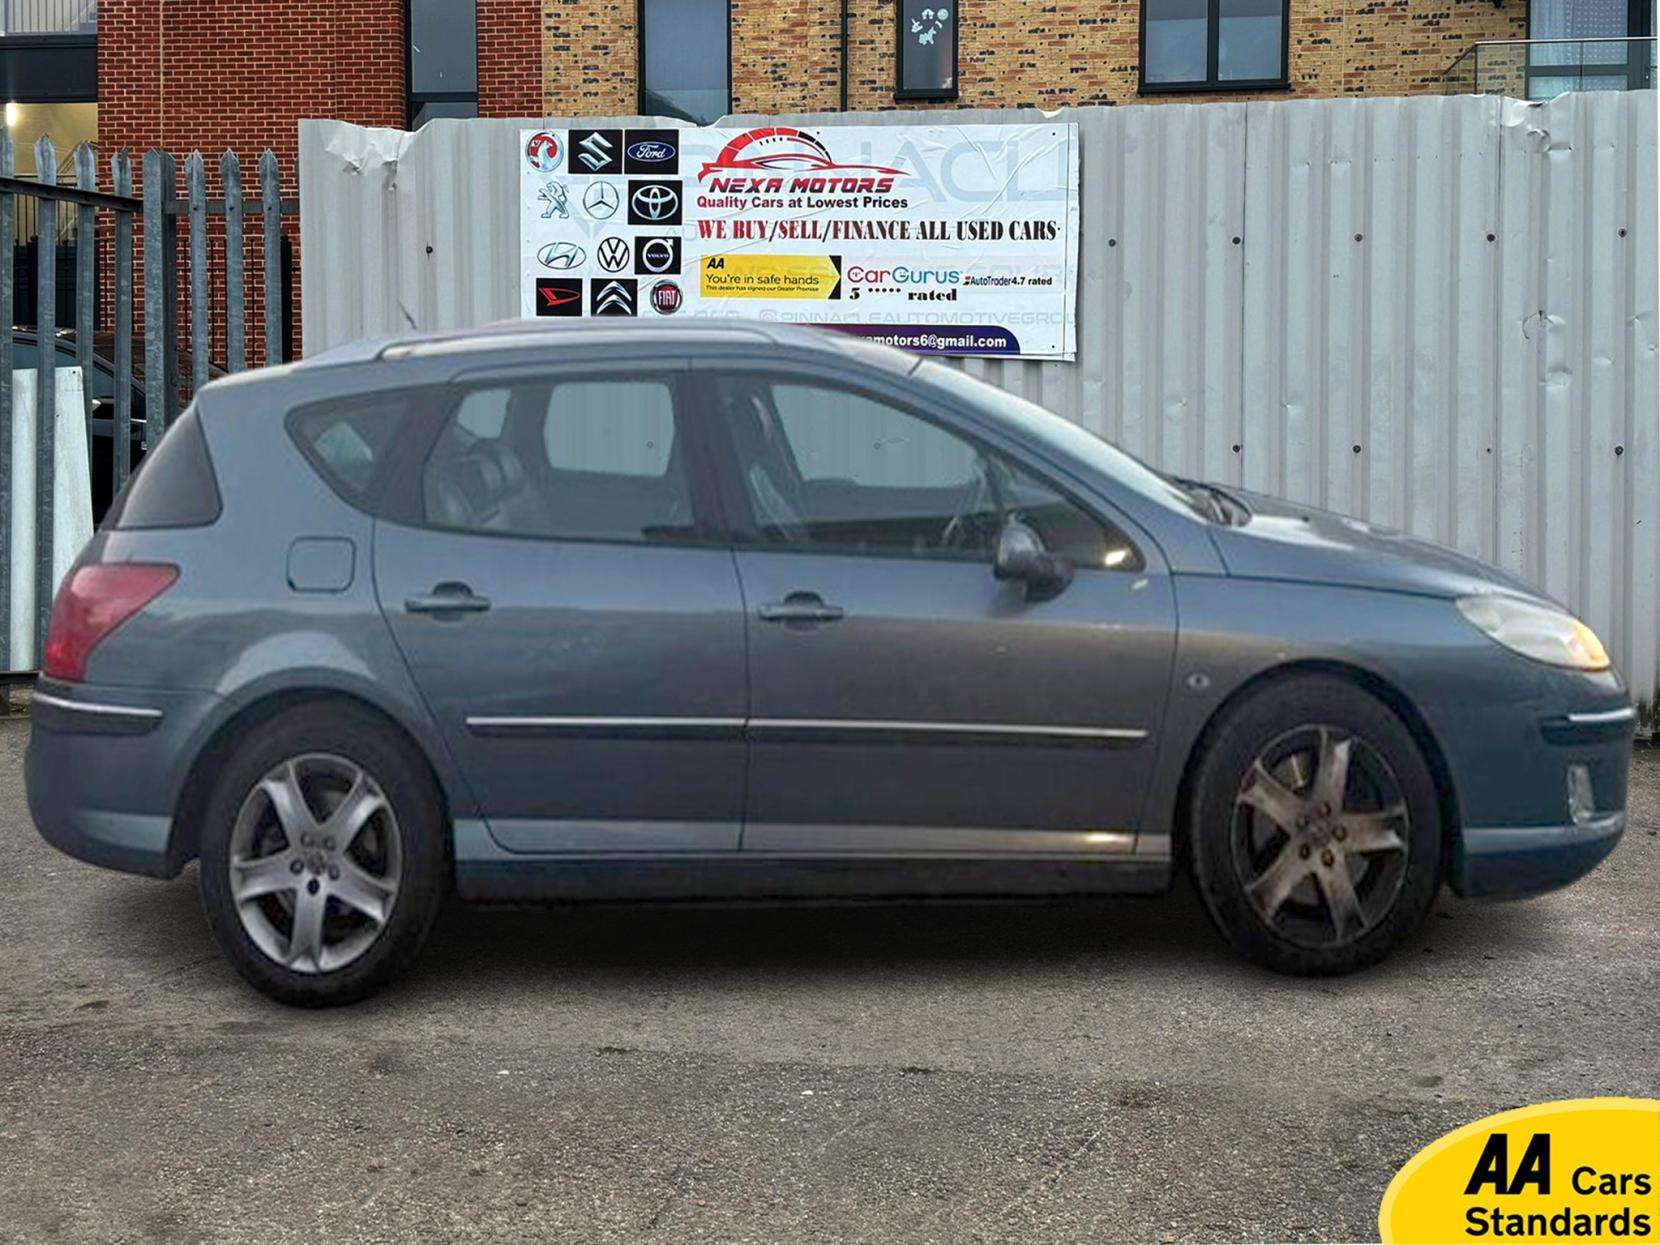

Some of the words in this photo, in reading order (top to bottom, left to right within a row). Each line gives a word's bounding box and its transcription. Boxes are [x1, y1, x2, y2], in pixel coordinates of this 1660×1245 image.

[636, 144, 666, 159] Ford
[708, 177, 784, 193] NEXA
[788, 177, 895, 193] MOTORS
[697, 196, 747, 210] Quality
[751, 196, 784, 208] Cars
[788, 197, 803, 208] at
[807, 197, 859, 208] Lowest
[863, 196, 908, 209] Prices
[697, 219, 727, 240] WE
[732, 219, 911, 243] BUY/SELL/FINANCE
[915, 220, 951, 241] ALL
[956, 220, 1004, 241] USED
[1008, 220, 1057, 241] CARS
[706, 258, 725, 269] AA
[705, 273, 741, 284] You're
[743, 274, 755, 284] in
[757, 274, 781, 285] safe
[783, 274, 820, 285] hands
[847, 266, 960, 284] CarGurus
[1027, 277, 1053, 286] rated
[658, 287, 677, 306] FIAT
[849, 287, 860, 300] 5
[908, 288, 957, 301] rated
